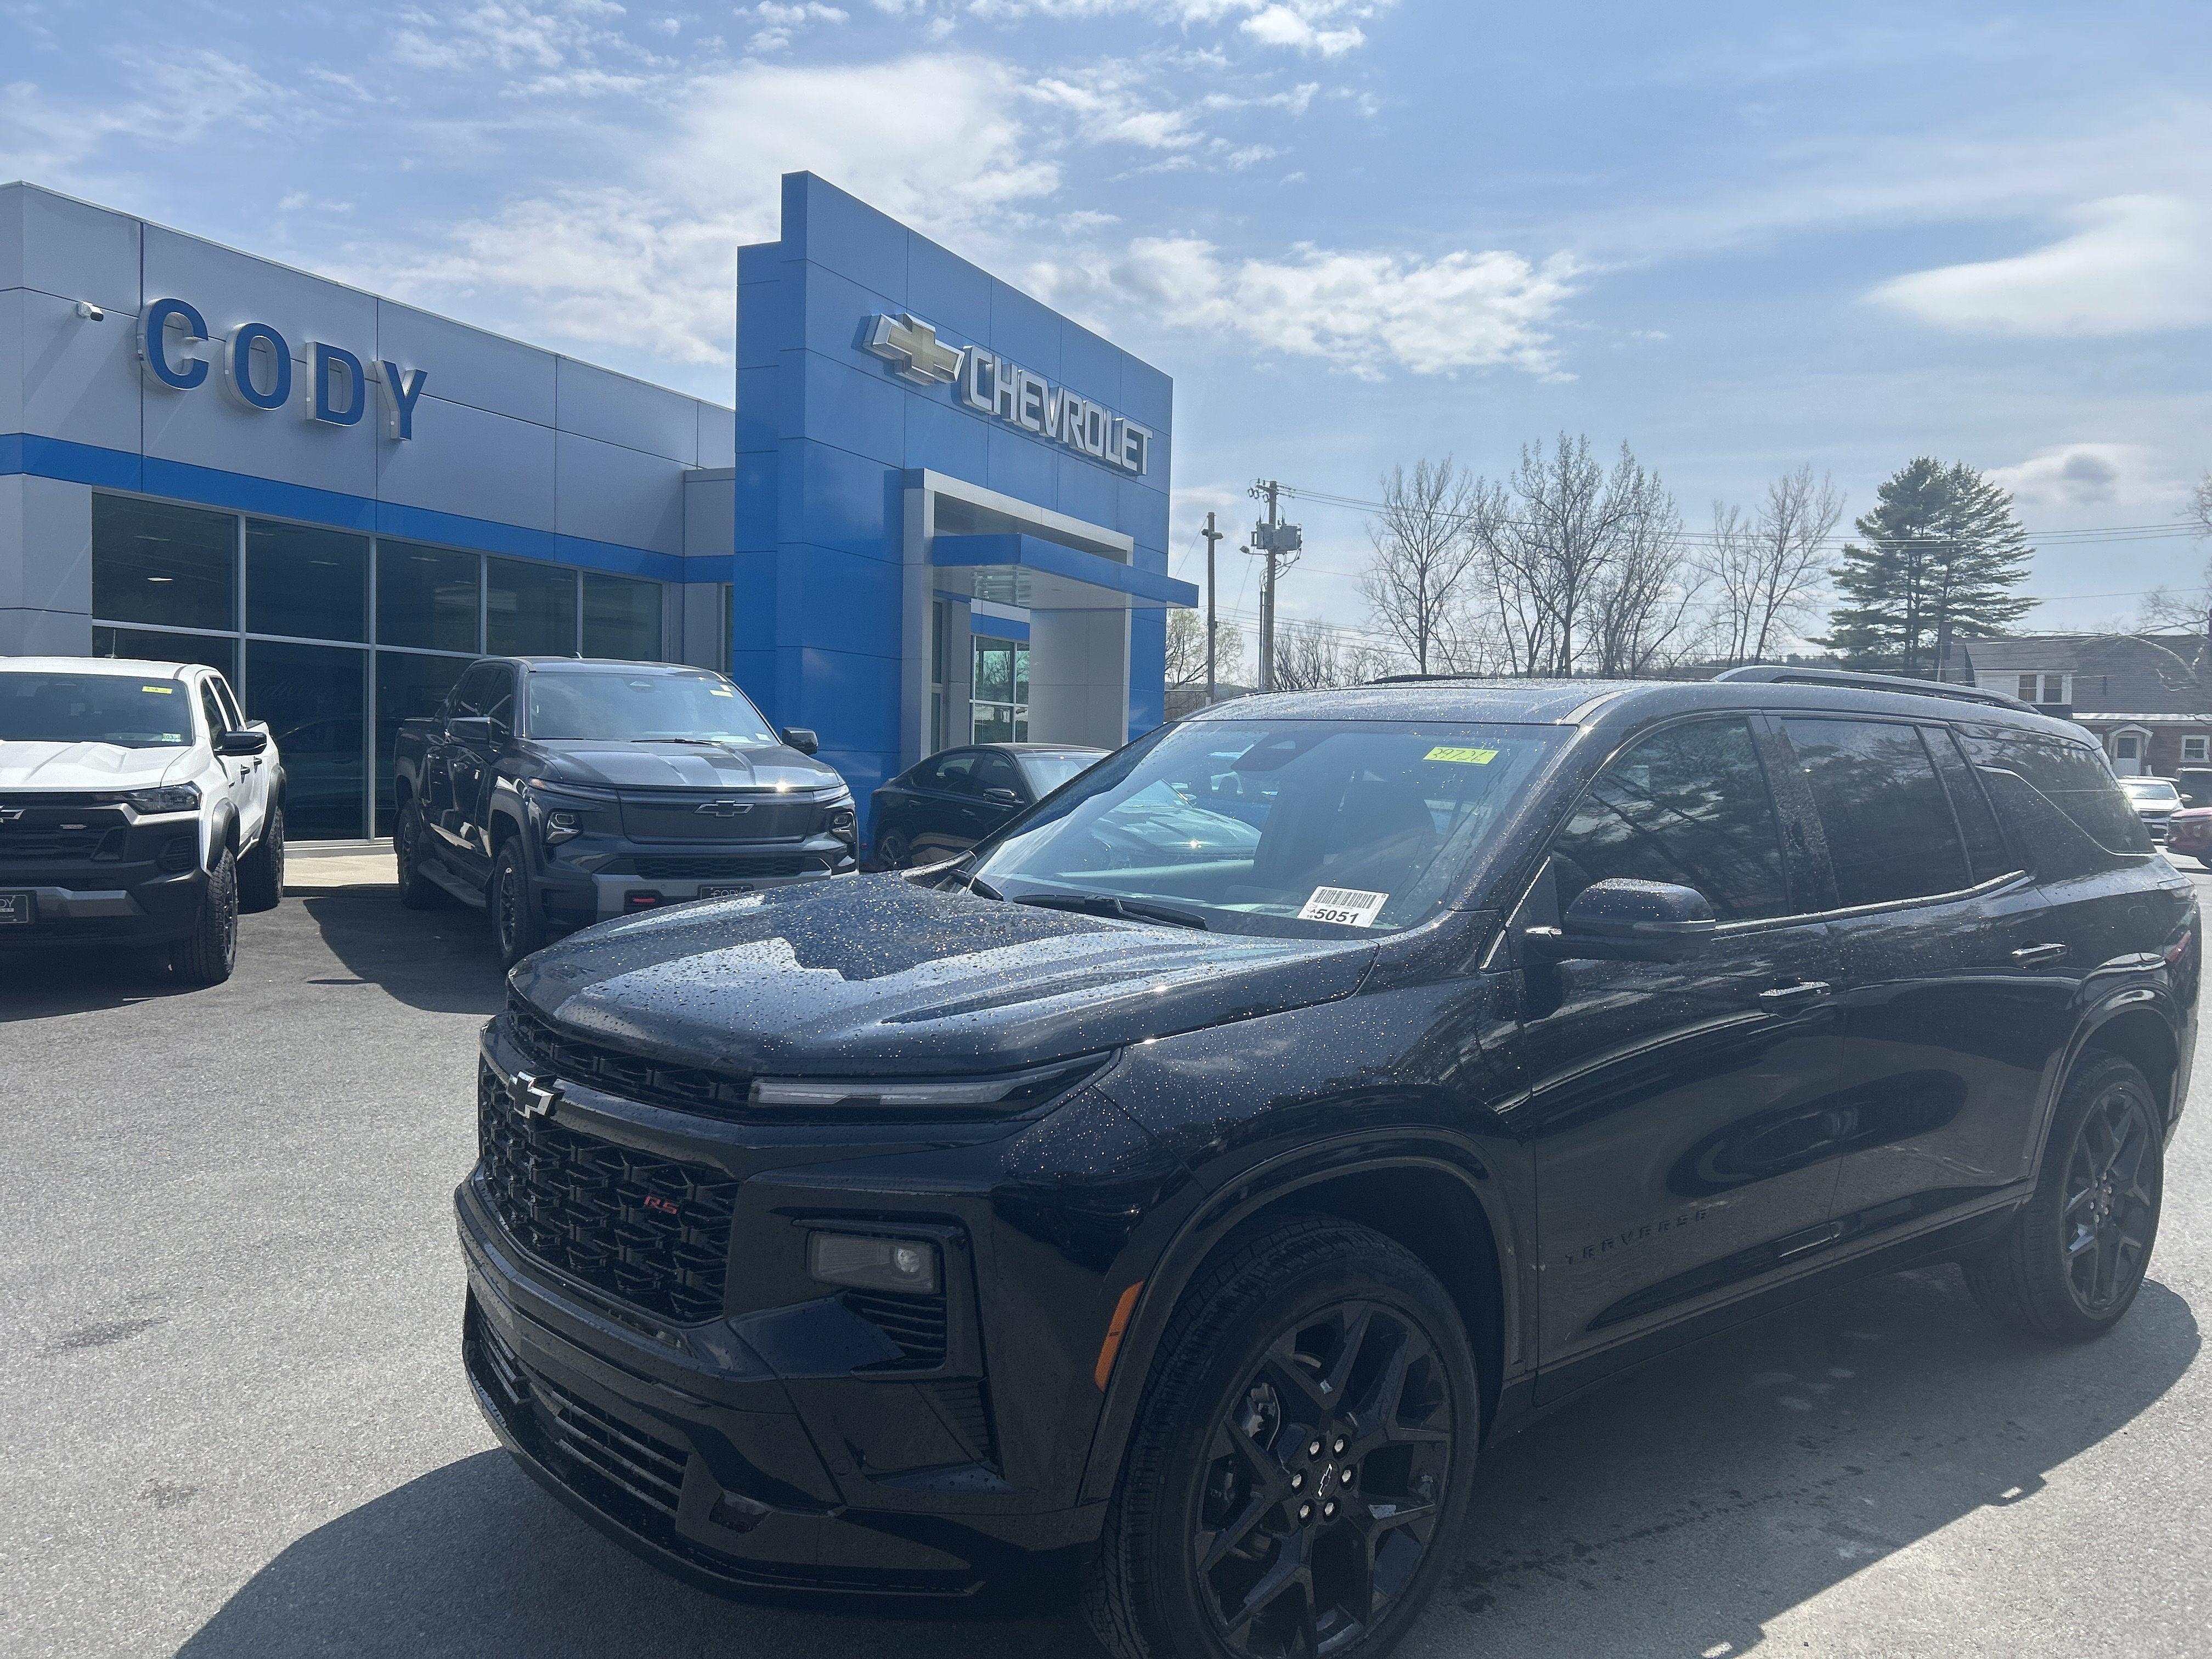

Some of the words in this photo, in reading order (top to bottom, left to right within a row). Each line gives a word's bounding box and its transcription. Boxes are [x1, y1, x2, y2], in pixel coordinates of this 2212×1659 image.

[138, 298, 427, 441] CODY
[964, 345, 1153, 476] CHEVROLET
[1313, 909, 1359, 924] 5051
[644, 1196, 679, 1215] RS
[1565, 1209, 1708, 1265] TRAVERSE
